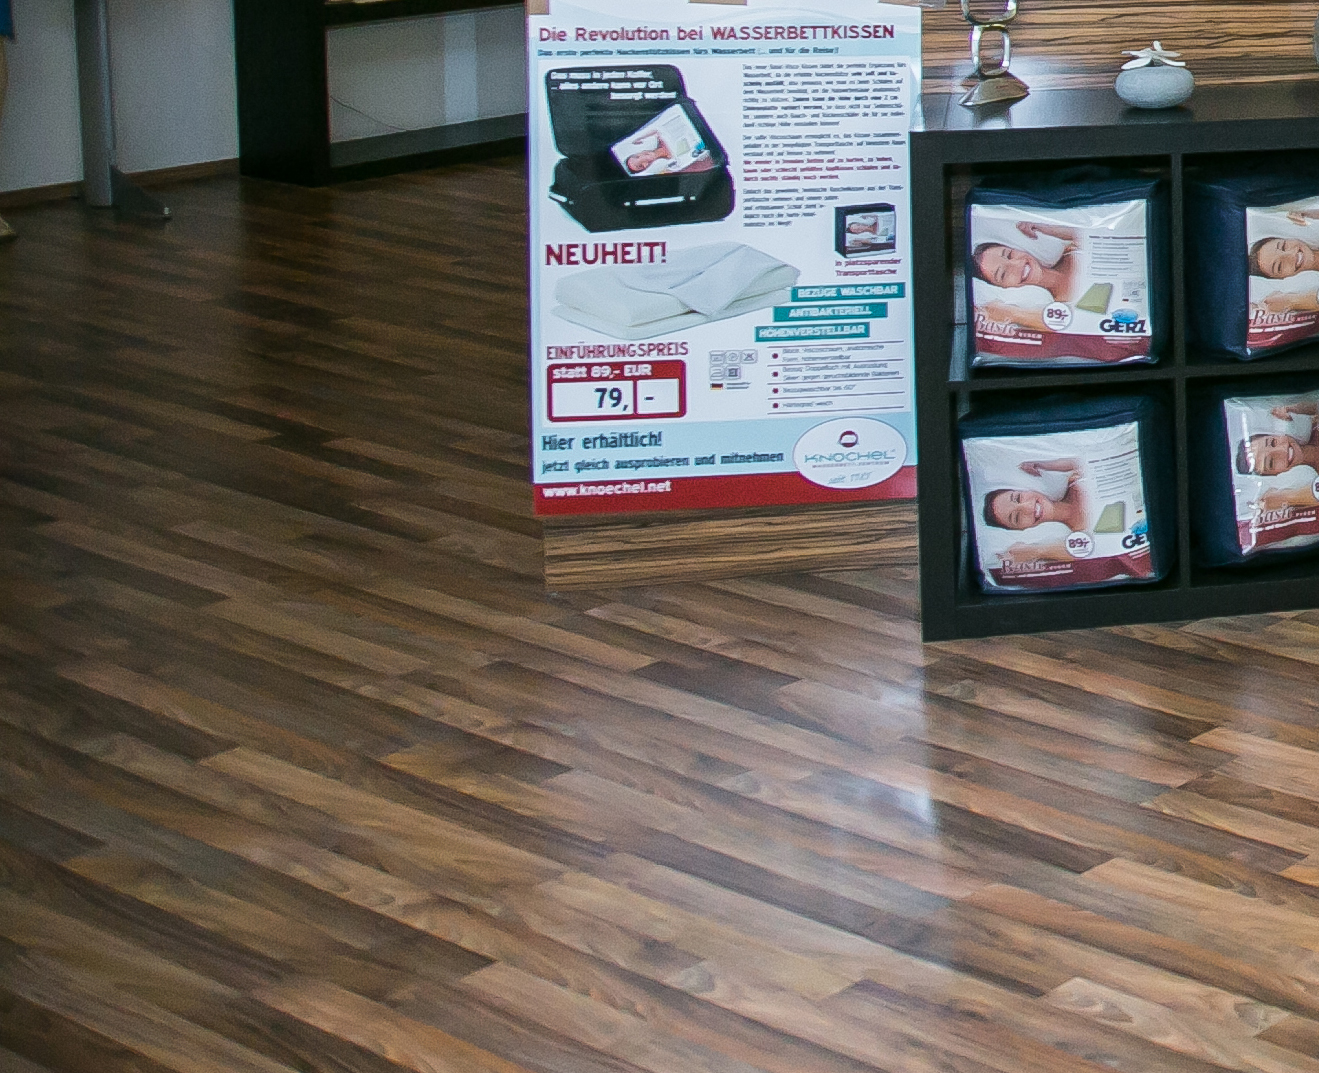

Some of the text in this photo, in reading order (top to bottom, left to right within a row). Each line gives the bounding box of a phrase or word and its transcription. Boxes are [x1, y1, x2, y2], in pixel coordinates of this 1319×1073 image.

[539, 24, 895, 42] Die Revolution bei WASSERBETTKISSEN
[544, 241, 668, 265] NEUHEIT!
[841, 285, 898, 297] WASCHBAR
[789, 305, 872, 318] ANTIBAKTERIELL
[759, 324, 866, 338] HÖHENVERSTELLBAR
[547, 341, 689, 360] EINFÜHRUNGSPREIS
[552, 364, 652, 379] statt 89,- EUR
[594, 387, 629, 411] 79,
[541, 430, 663, 451] Hier erhältlich!
[542, 451, 784, 474] jetzt gleich ausprobieren und mitnehmen
[542, 480, 671, 498] www.knoechel.net
